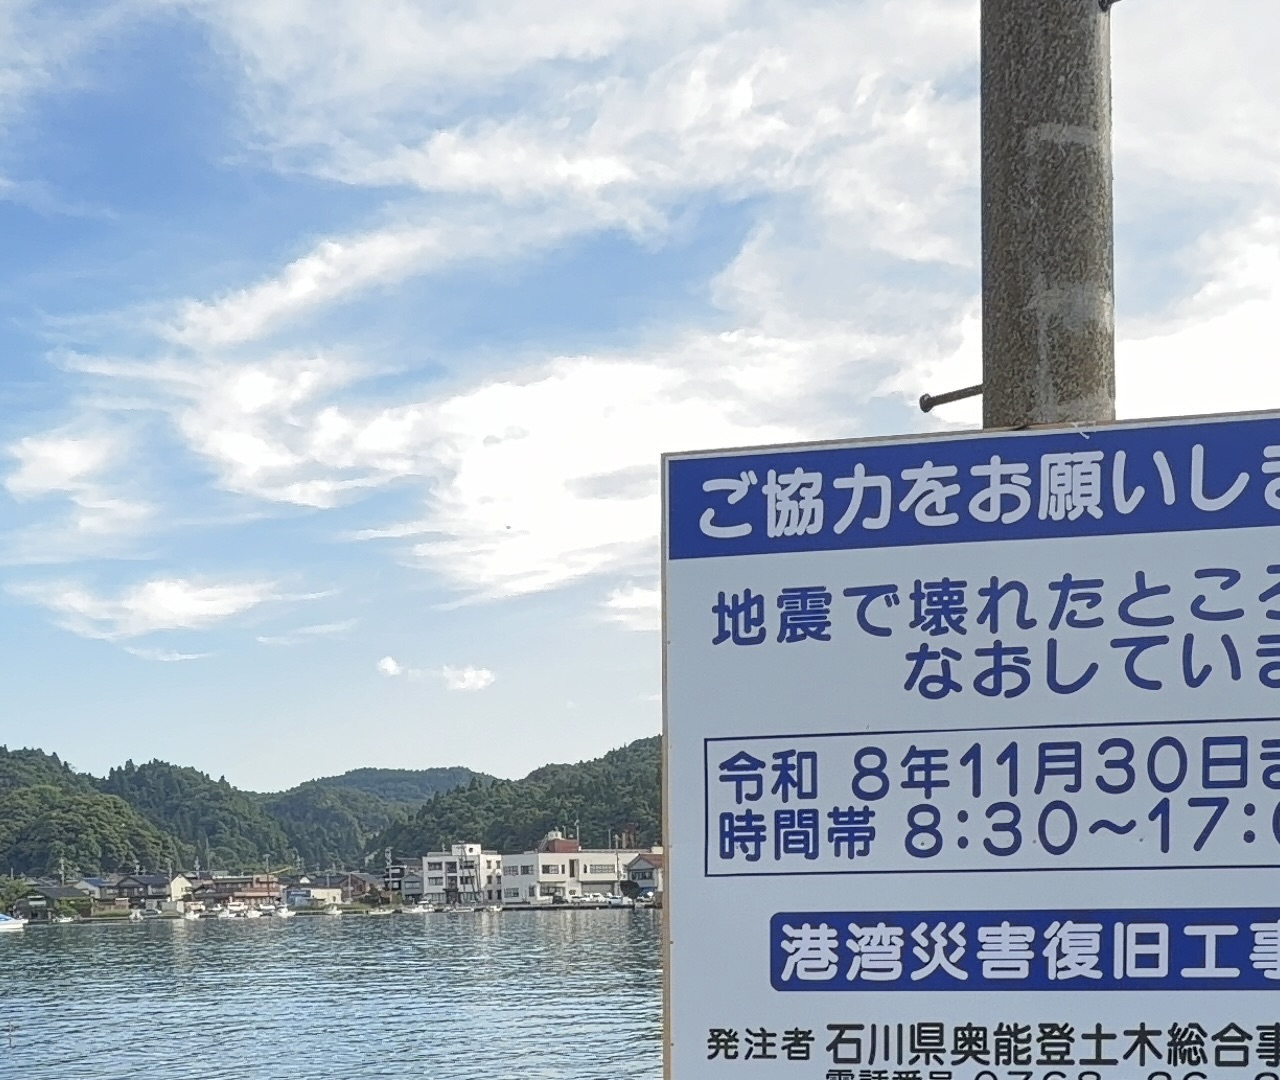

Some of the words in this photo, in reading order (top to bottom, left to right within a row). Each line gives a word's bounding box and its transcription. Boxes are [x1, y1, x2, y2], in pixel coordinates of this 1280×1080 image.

[718, 748, 818, 804] 令和
[719, 805, 876, 862] 時間帯
[707, 1026, 816, 1061] 発注者
